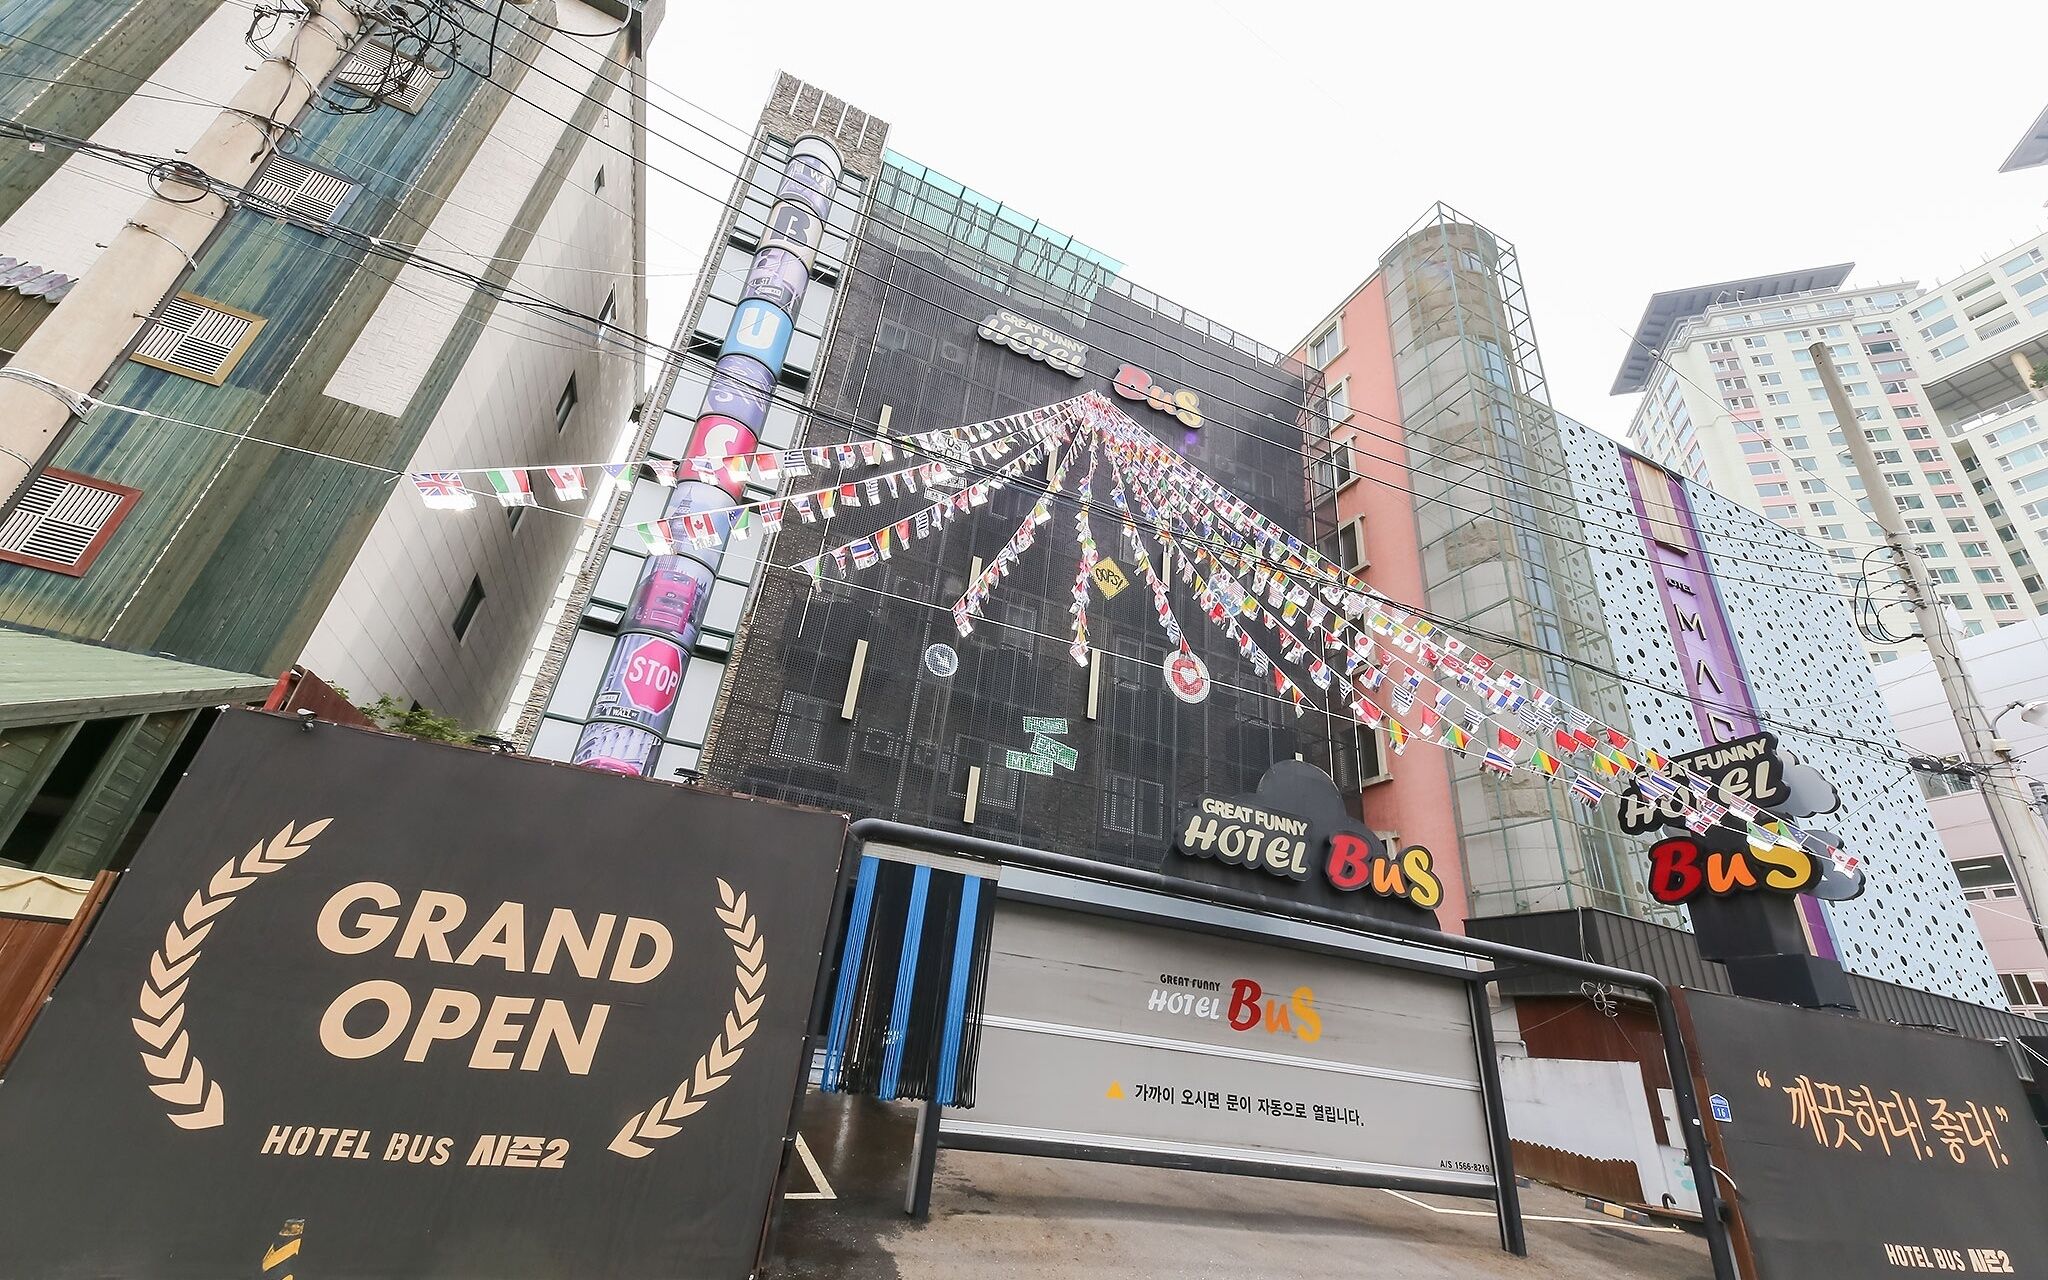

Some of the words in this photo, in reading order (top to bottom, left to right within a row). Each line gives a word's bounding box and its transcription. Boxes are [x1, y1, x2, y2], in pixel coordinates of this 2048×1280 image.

[1000, 312, 1041, 336] GREAT
[1041, 325, 1085, 353] FUNNY
[1095, 568, 1123, 590] OOPS!
[628, 656, 679, 695] STOP
[1695, 738, 1767, 771] FUNNY
[1202, 798, 1253, 823] GREAT
[1255, 809, 1308, 837] FUNNY
[316, 880, 674, 985] GRAND
[1160, 973, 1190, 988] GREAT
[1191, 978, 1222, 992] FUNNY
[318, 978, 612, 1076] OPEN
[1134, 1083, 1176, 1105] 가까이
[1181, 1088, 1221, 1110] 오시면
[1226, 1093, 1252, 1114] 문이
[1257, 1097, 1308, 1120] 자동으로
[1312, 1104, 1366, 1127] 열립니다.
[260, 1125, 371, 1160] HOTEL
[382, 1132, 454, 1167] BUS
[465, 1134, 570, 1169] 시즌2
[1440, 1159, 1453, 1169] A/S
[1454, 1161, 1490, 1173] 1566-8219
[1883, 1243, 1934, 1269] HOTEL
[1932, 1247, 1966, 1272] BUS
[1967, 1248, 2015, 1274] 시즌2
